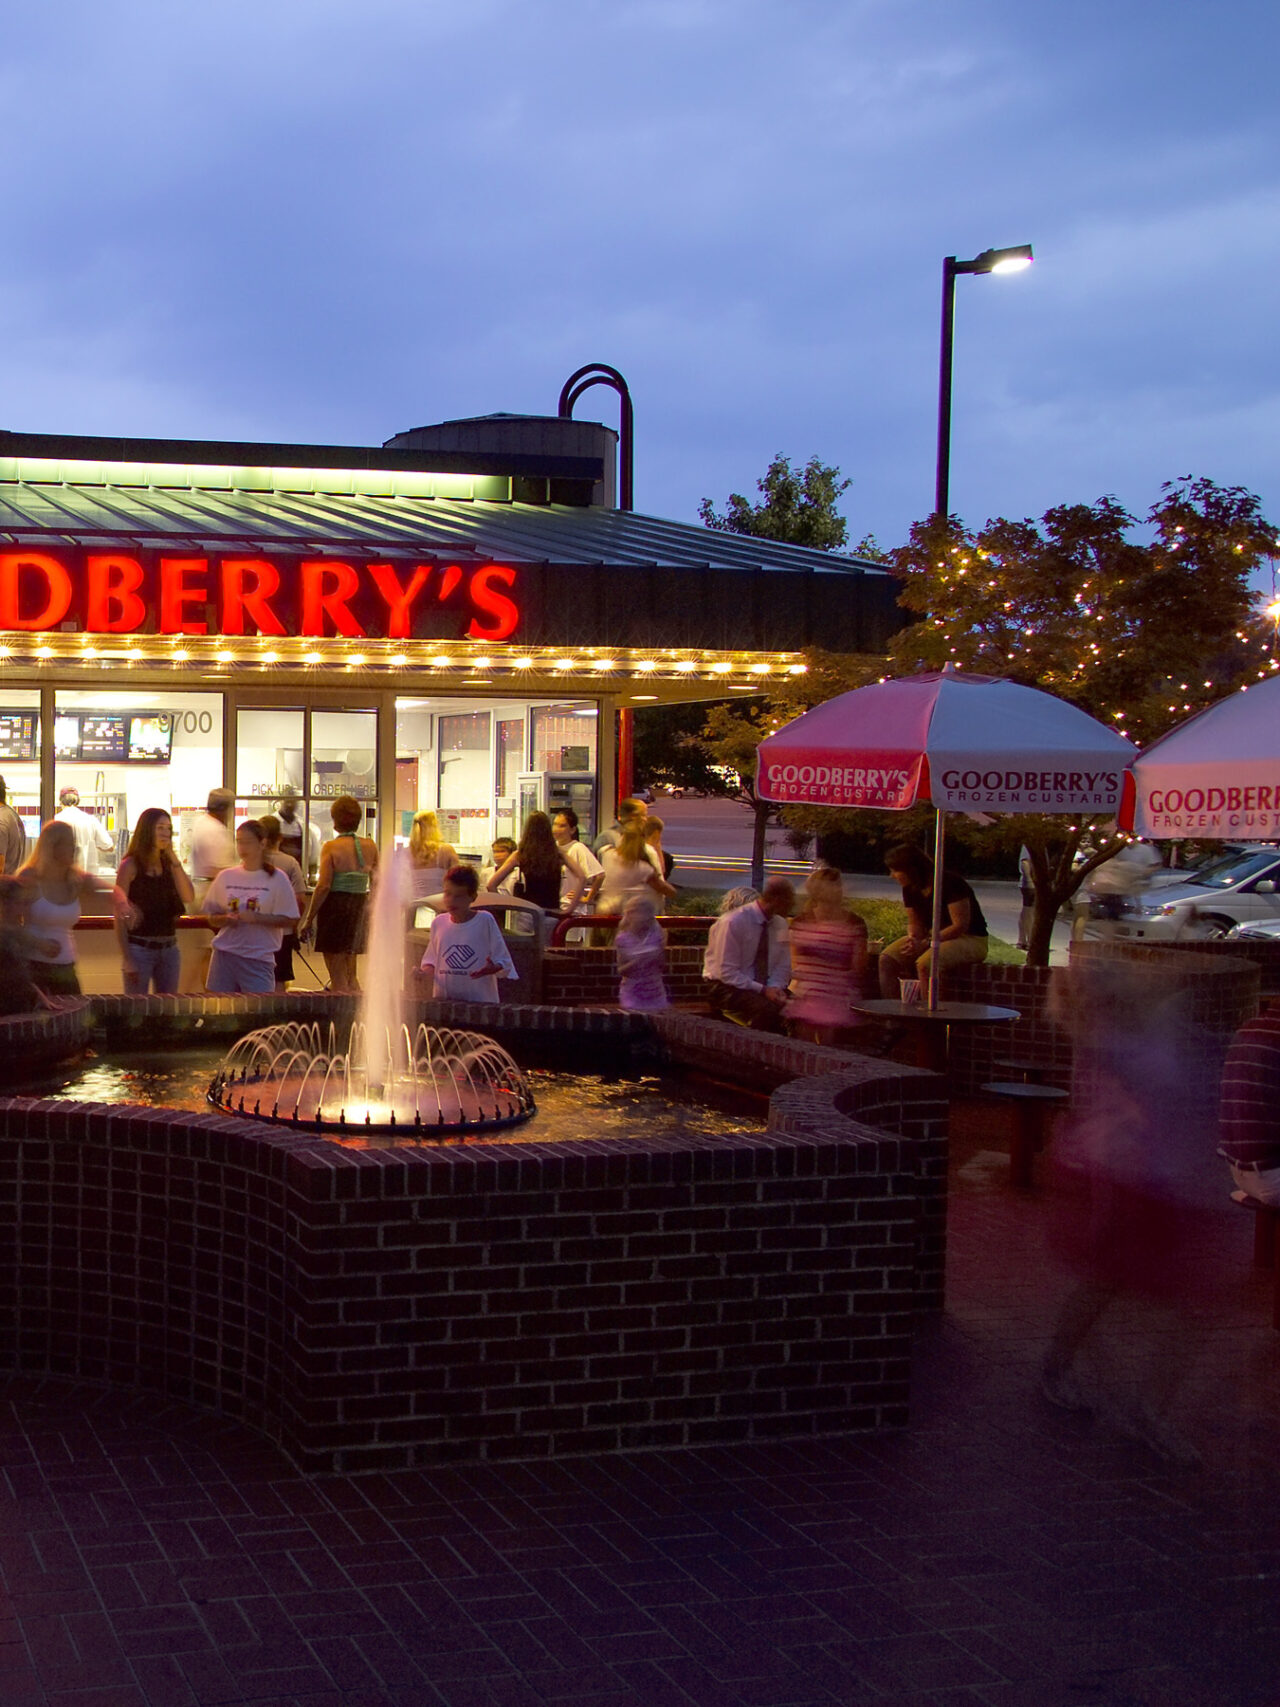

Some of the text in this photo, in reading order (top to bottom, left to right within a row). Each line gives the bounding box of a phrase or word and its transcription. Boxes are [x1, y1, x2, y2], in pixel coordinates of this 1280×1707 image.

[158, 711, 213, 733] 9700
[767, 764, 910, 790] GOODBERRY'S
[941, 770, 1119, 792] GOODBERRY'S
[251, 783, 274, 796] PICK
[313, 783, 348, 796] ORDER
[770, 783, 906, 802] FROZEN CUSTARD
[947, 791, 1117, 804] FROZEN CUSTARD
[1152, 814, 1221, 827] FROZEN
